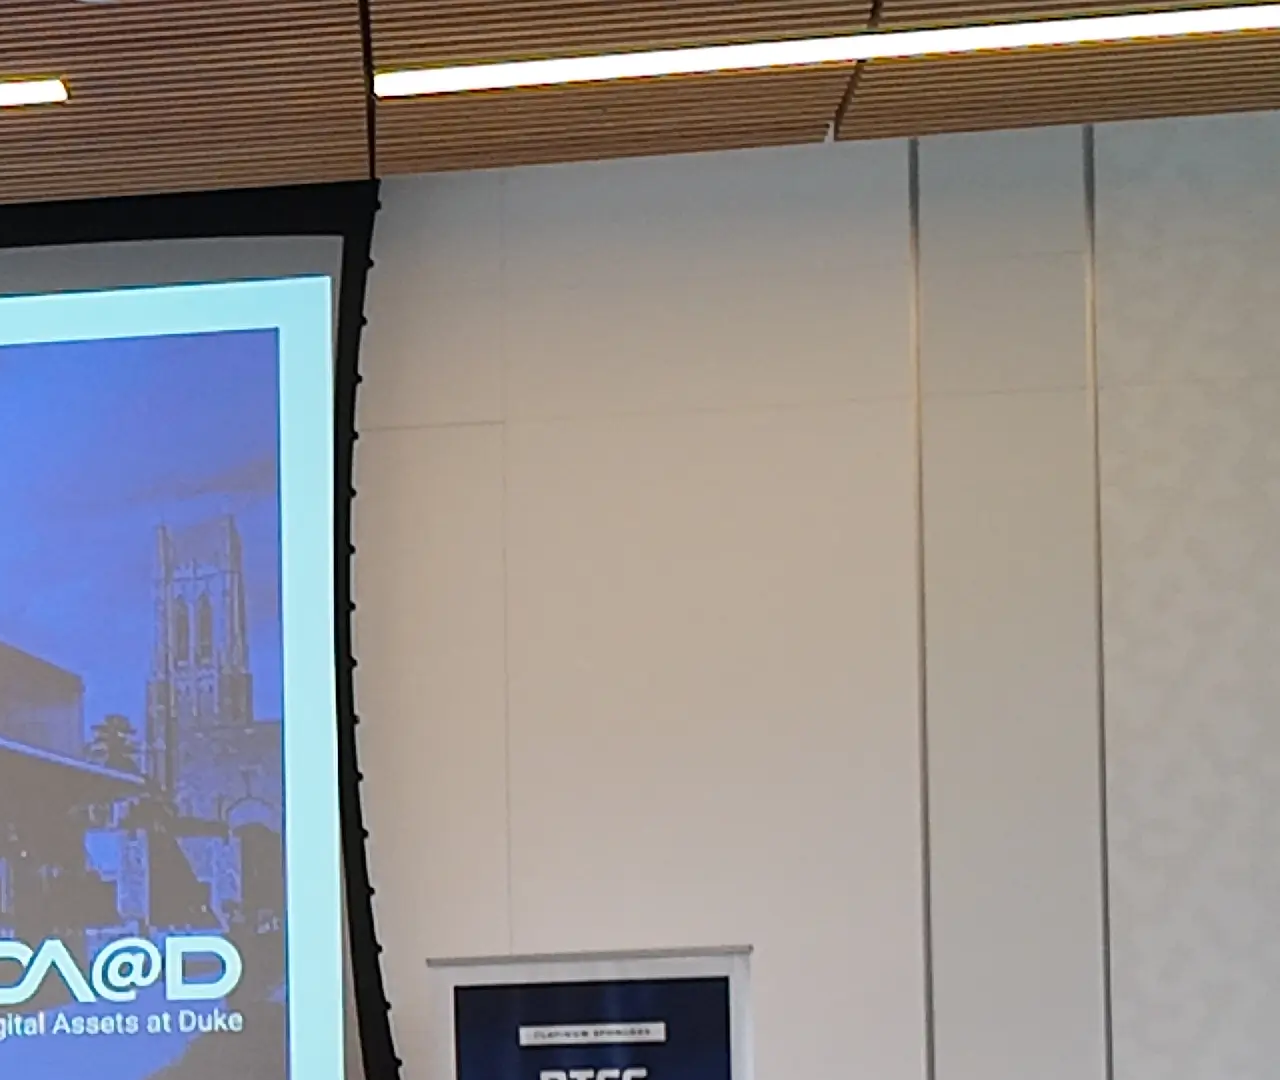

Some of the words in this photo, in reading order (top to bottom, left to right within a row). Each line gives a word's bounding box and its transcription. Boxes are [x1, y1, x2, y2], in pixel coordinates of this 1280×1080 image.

[52, 1012, 139, 1035] Assets
[146, 1012, 172, 1034] at
[179, 1009, 243, 1032] Duke
